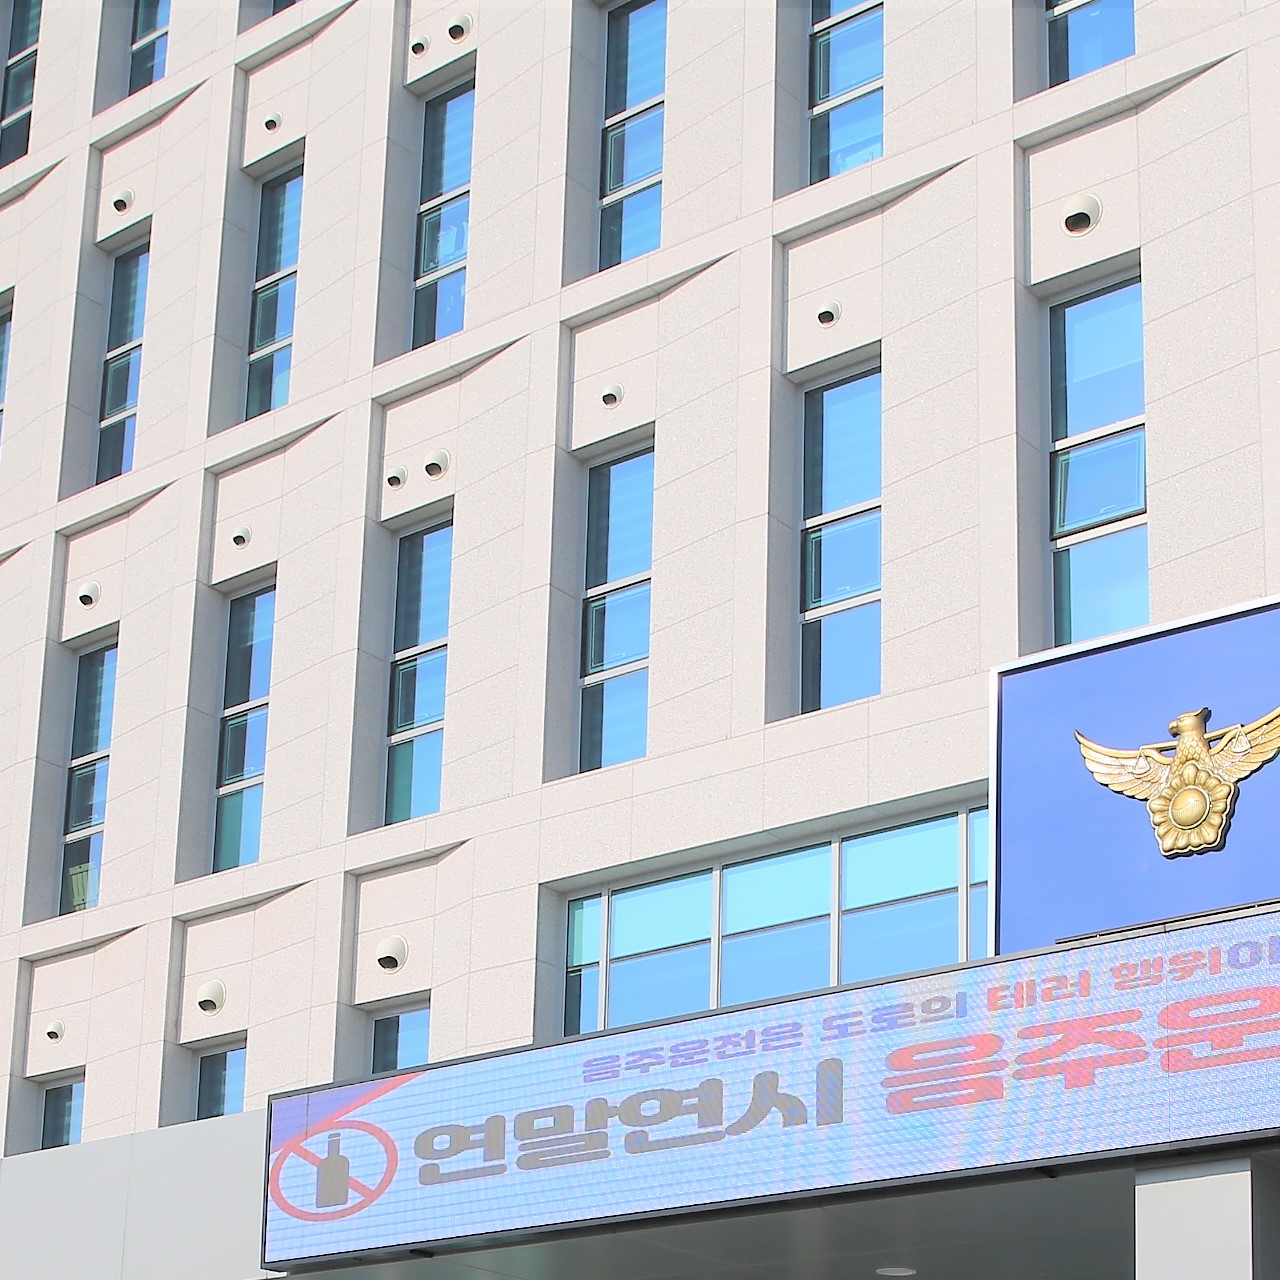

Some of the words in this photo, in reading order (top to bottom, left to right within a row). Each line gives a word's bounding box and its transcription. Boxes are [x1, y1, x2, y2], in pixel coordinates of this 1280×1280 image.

[581, 1022, 805, 1083] 음주운전은
[821, 993, 967, 1039] 도로의
[987, 973, 1091, 1013] 테러
[414, 1058, 844, 1186] 연말연시
